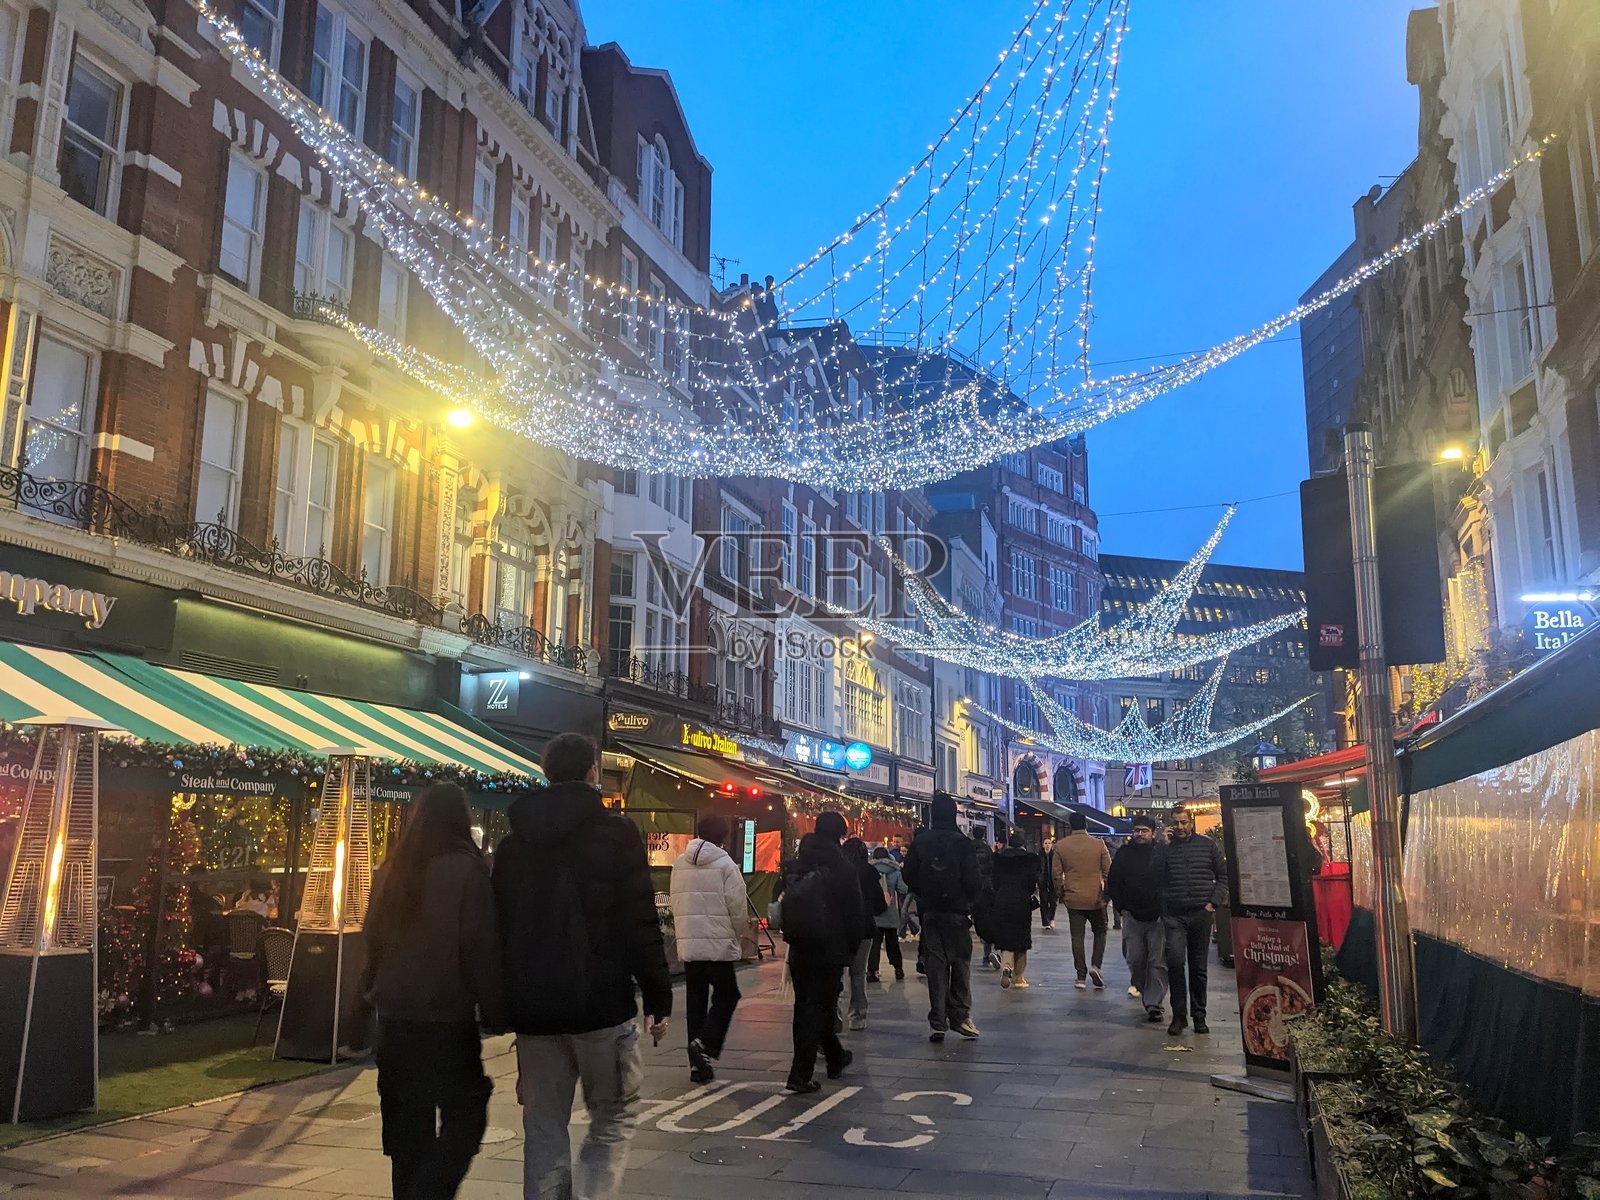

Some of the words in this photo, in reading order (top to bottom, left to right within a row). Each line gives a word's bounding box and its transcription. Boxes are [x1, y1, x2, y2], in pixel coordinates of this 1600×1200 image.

[1534, 610, 1584, 629] Bella
[1534, 632, 1575, 650] Ital
[488, 679, 508, 704] Z
[180, 773, 215, 789] Steak
[215, 777, 230, 788] and
[230, 777, 277, 796] Company
[376, 786, 413, 802] Company
[1230, 788, 1253, 801] Bella
[1243, 948, 1300, 966] Christmas!
